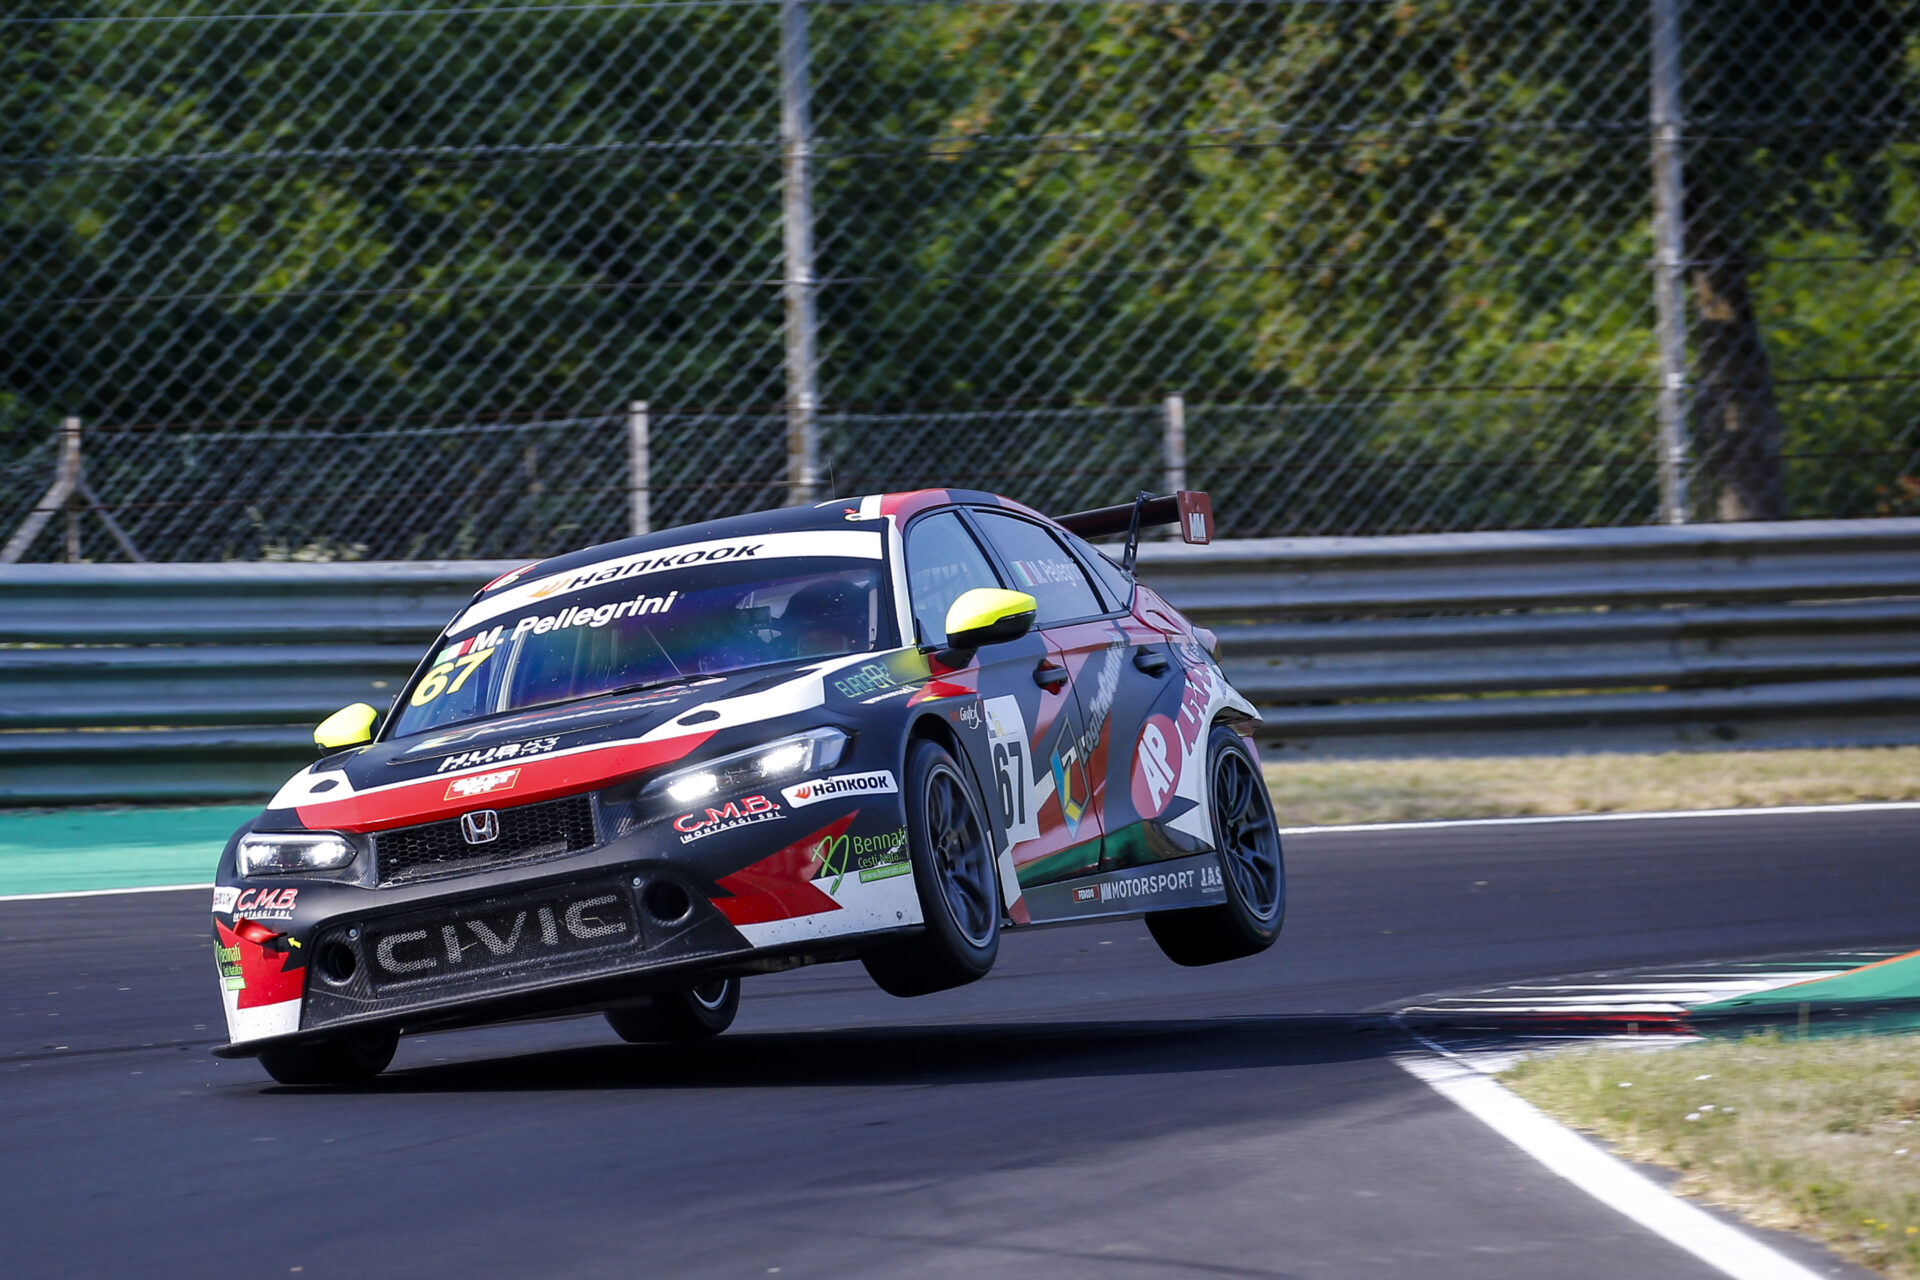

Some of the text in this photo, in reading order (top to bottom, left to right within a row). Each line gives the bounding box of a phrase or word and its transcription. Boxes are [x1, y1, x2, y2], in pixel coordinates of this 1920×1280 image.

[468, 590, 678, 653] M. Pellegrini
[410, 646, 496, 707] 67
[993, 740, 1026, 829] 67
[1138, 722, 1175, 812] AP
[672, 793, 782, 833] C.M.B.
[683, 811, 781, 842] MONTAGGI SRL
[1111, 869, 1195, 900] MOTORSPORT
[1200, 865, 1224, 888] JAS
[236, 887, 299, 911] C.M.B.
[274, 910, 291, 919] SRL
[375, 893, 628, 975] CIVIC
